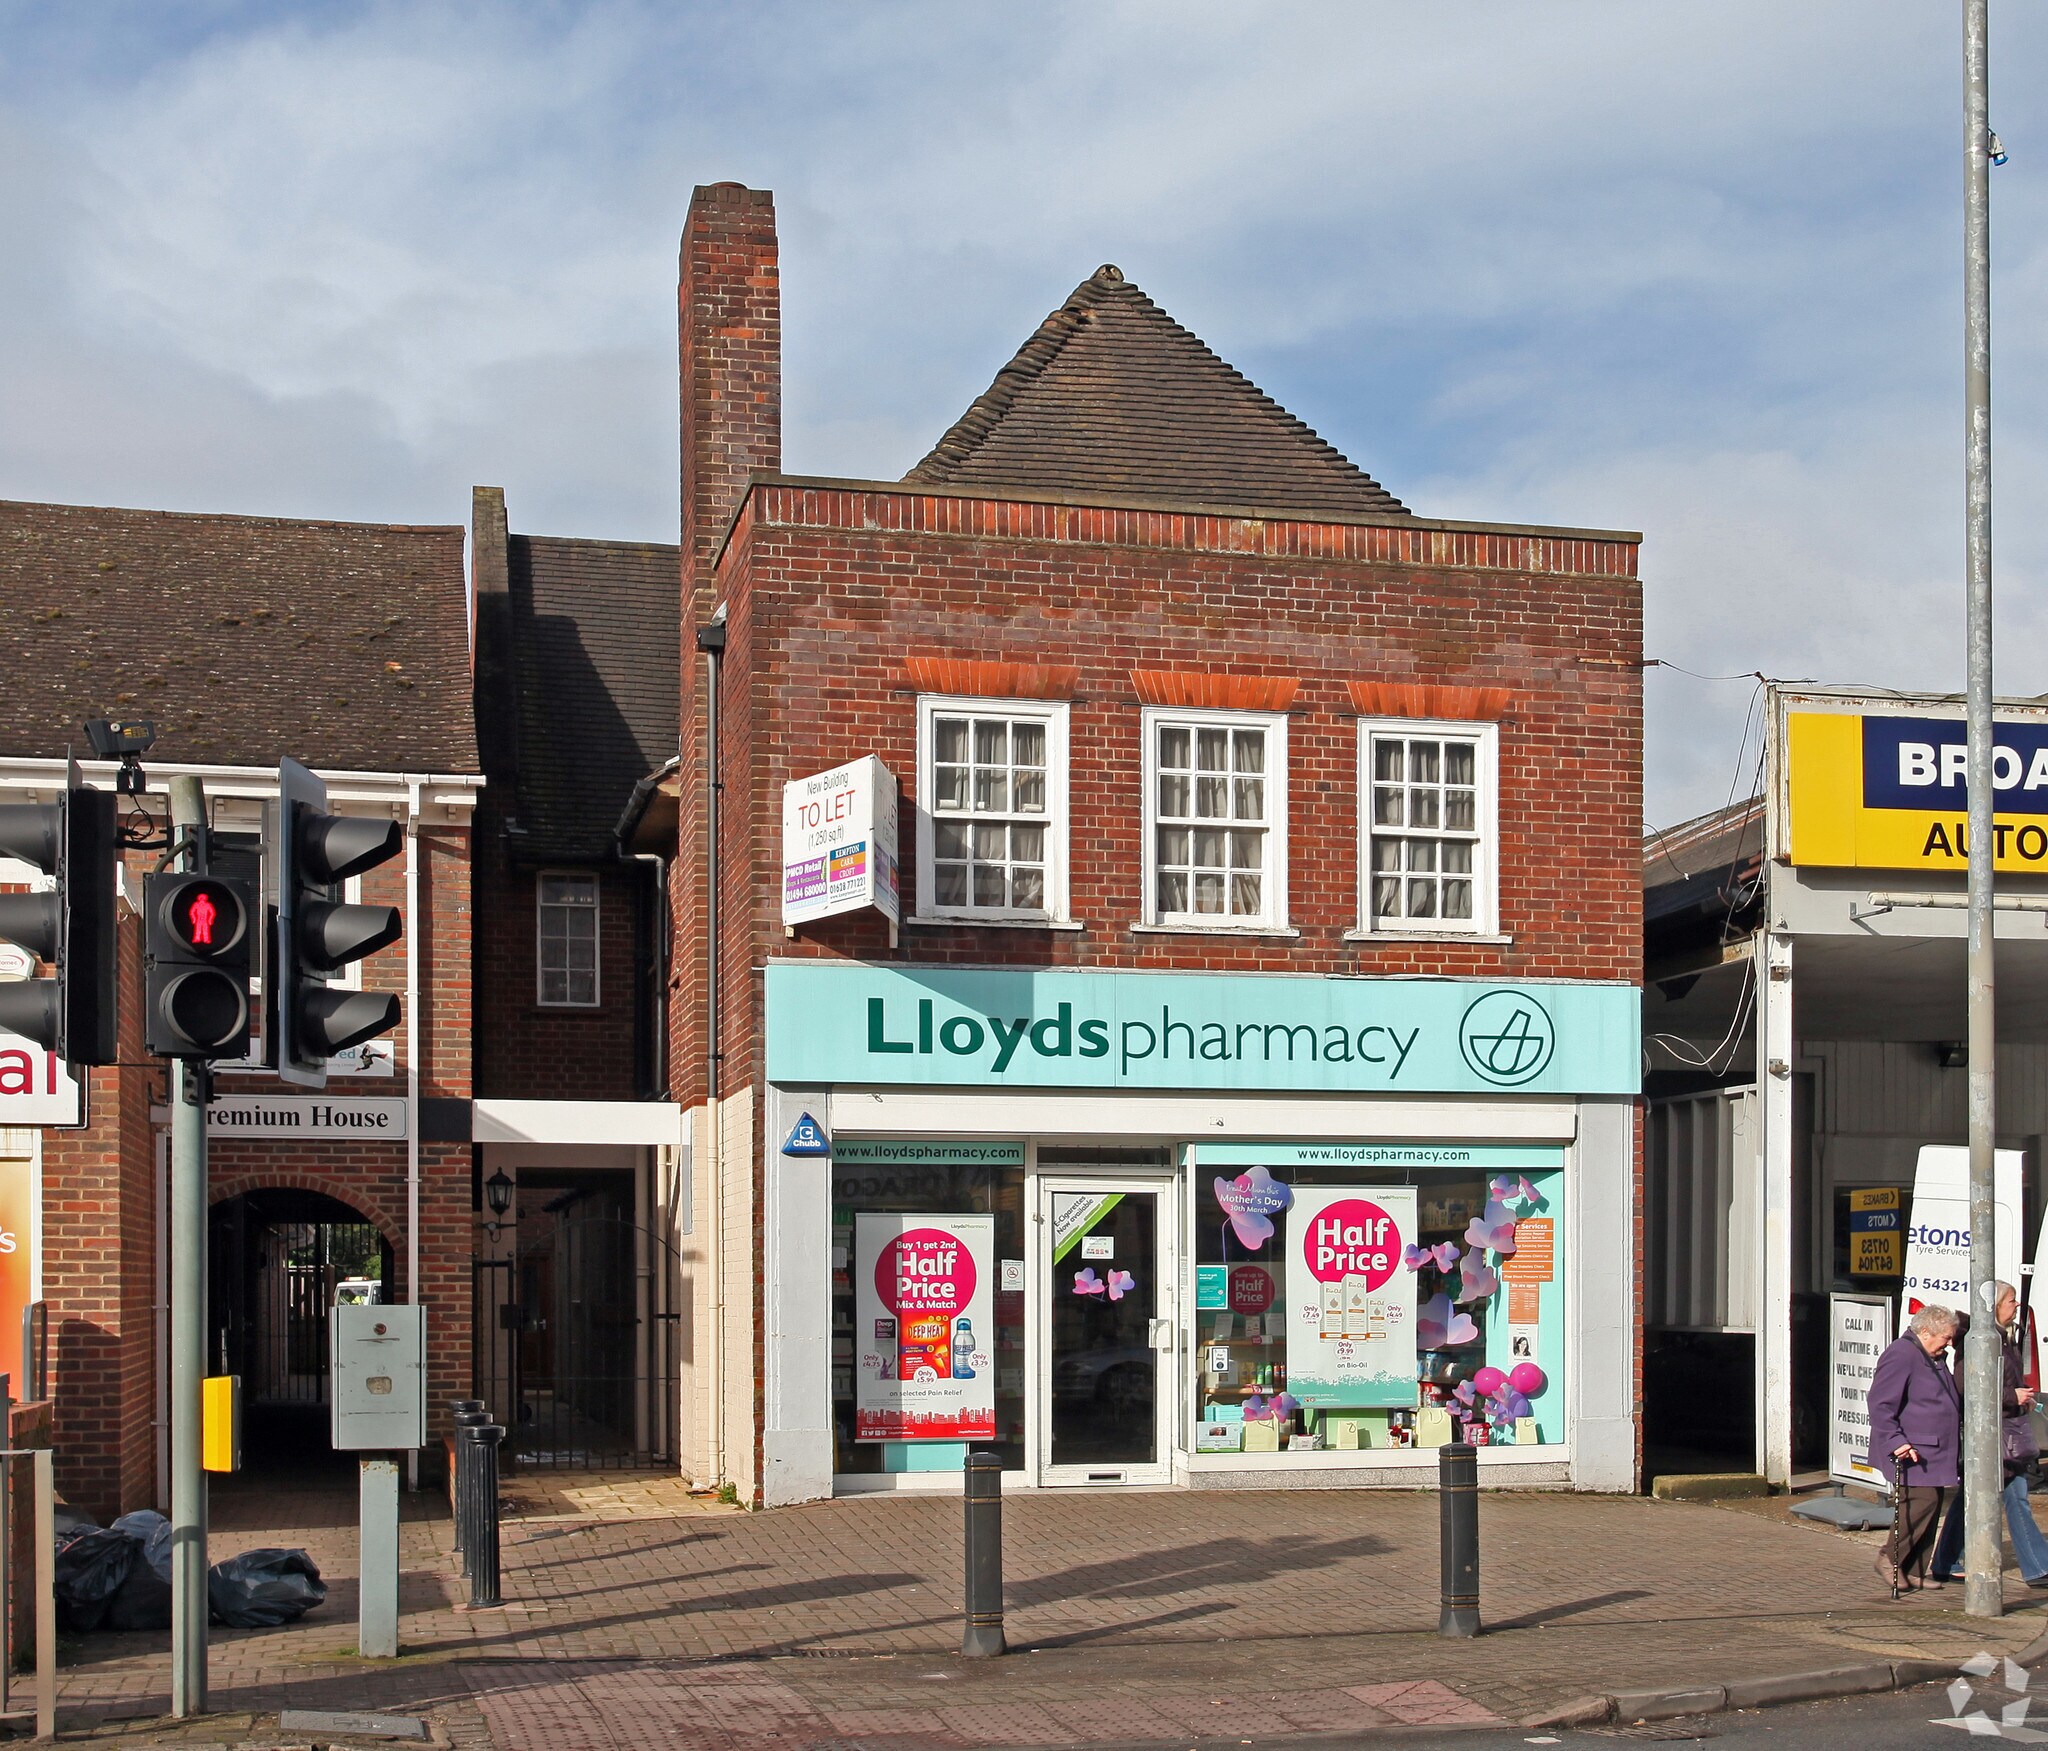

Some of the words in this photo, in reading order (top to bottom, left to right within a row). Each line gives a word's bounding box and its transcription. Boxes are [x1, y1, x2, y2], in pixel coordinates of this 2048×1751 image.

[1898, 742, 2048, 790] BROA
[807, 780, 822, 796] New
[823, 772, 849, 791] Building
[798, 802, 820, 830] TO
[825, 789, 856, 823] LET
[835, 844, 860, 858] KEMPTON
[804, 860, 822, 873] Retail
[840, 857, 854, 867] CARR
[839, 867, 856, 878] CROFT
[847, 877, 866, 889] 771221
[786, 888, 803, 901] 01494
[207, 1105, 300, 1126] remium
[311, 1106, 389, 1127] House
[793, 1139, 821, 1147] Chubb
[835, 1145, 1020, 1160] www.lloydspharmacy.com
[1297, 1148, 1470, 1162] www.lloydspharmacy.com
[1220, 1194, 1262, 1204] Mother's
[1264, 1197, 1283, 1208] Day
[1230, 1204, 1246, 1212] 30th
[1053, 1196, 1086, 1227] E-Cigarettes
[1056, 1222, 1071, 1235] Now
[1069, 1199, 1094, 1222] available
[1317, 1217, 1391, 1247] Half
[1908, 1224, 1970, 1247] etons
[896, 1241, 913, 1251] Buy
[916, 1241, 921, 1249] 1
[923, 1242, 938, 1251] get
[940, 1240, 957, 1249] 2nd
[1915, 1244, 1934, 1255] Tyre
[1936, 1246, 1971, 1257] Services
[896, 1251, 958, 1276] Half
[1317, 1247, 1388, 1271] Price
[896, 1277, 956, 1298] Price
[1235, 1279, 1265, 1291] Half
[1923, 1278, 1968, 1292] 54321
[1235, 1292, 1264, 1302] Price
[896, 1300, 914, 1309] Mix
[916, 1300, 925, 1309] &
[926, 1300, 957, 1309] Match
[908, 1325, 926, 1338] DEEP
[927, 1325, 944, 1338] HEAT
[1845, 1318, 1862, 1331] CALL
[1864, 1320, 1873, 1331] IN
[1839, 1341, 1871, 1355] ANYTIME
[1873, 1345, 1879, 1356] &
[1837, 1364, 1855, 1377] WE'LL
[1841, 1387, 1858, 1400] YOUR
[1839, 1432, 1853, 1445] FOR
[1855, 1435, 1870, 1447] FRE
